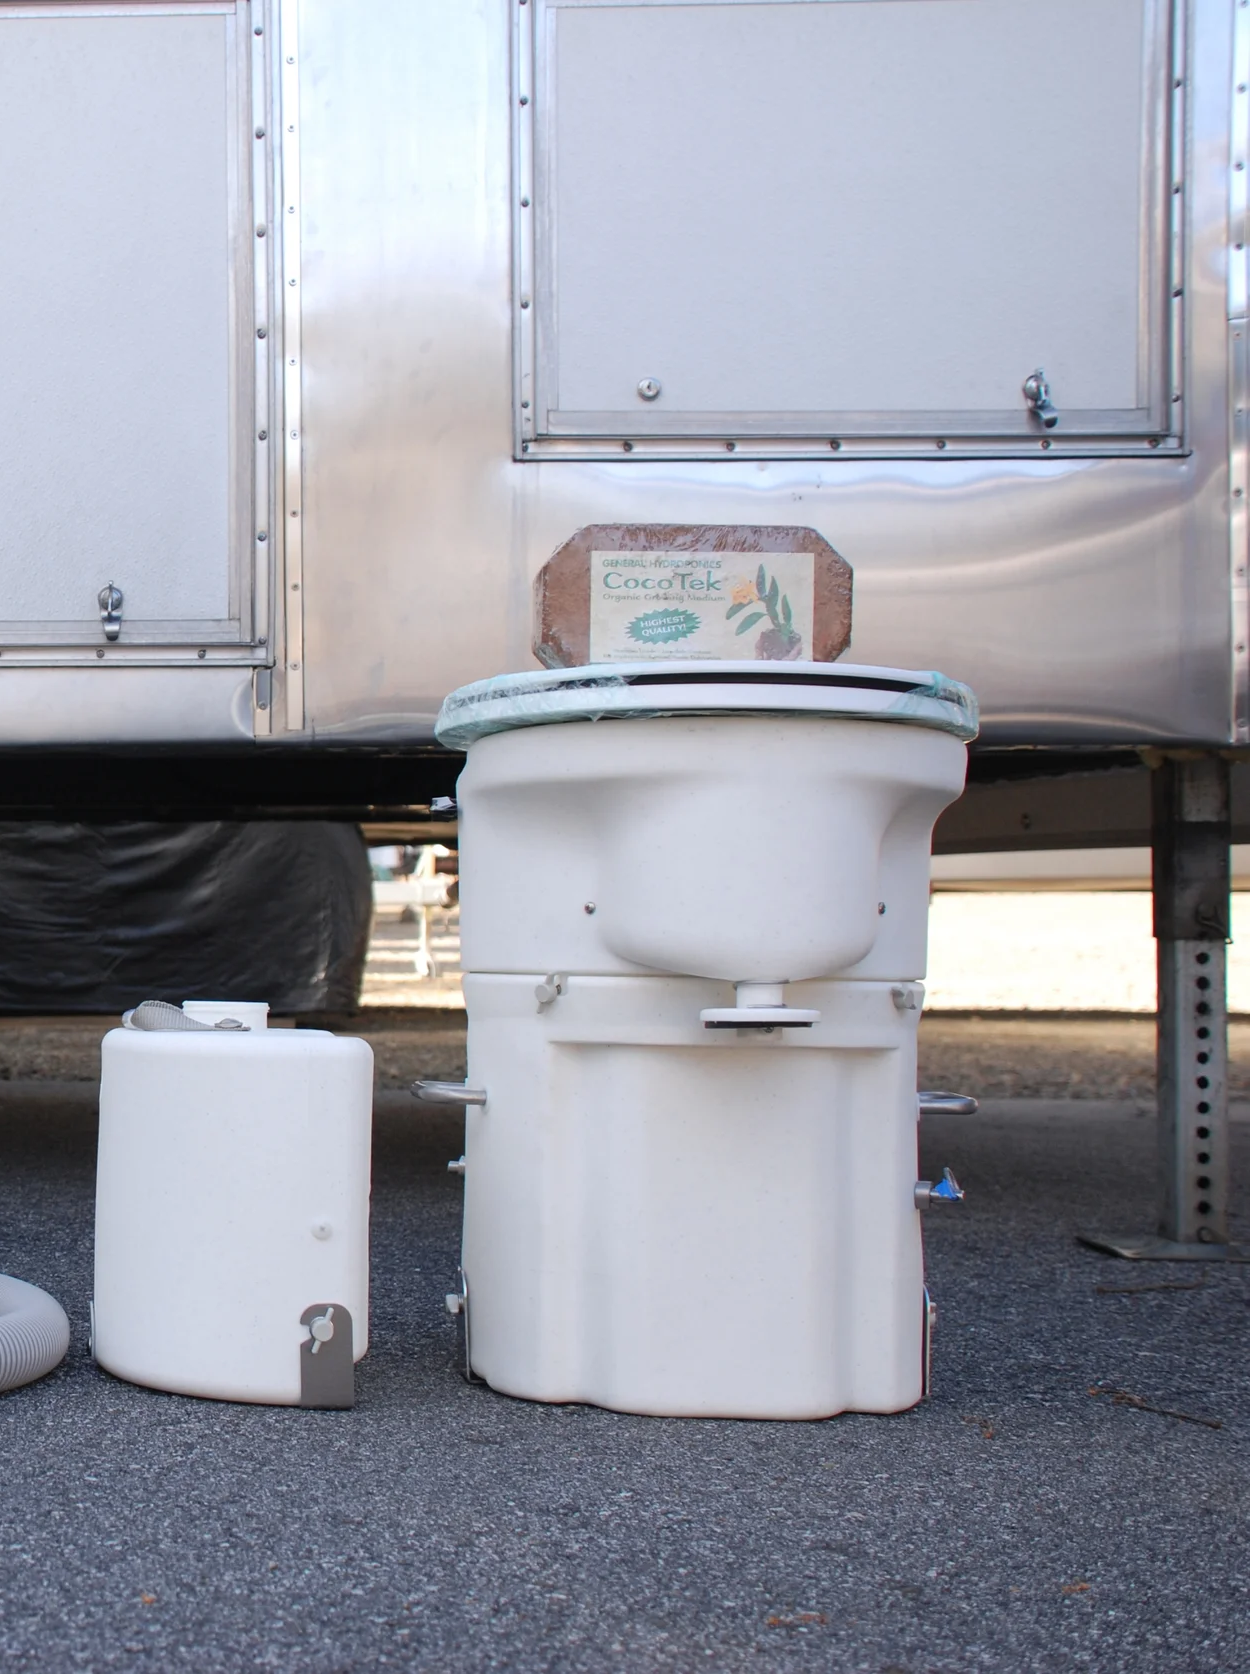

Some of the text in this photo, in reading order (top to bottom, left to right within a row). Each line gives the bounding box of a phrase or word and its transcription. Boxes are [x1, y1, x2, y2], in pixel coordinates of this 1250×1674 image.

[602, 559, 722, 569] GENERAL HYDROPONICS
[602, 593, 641, 603] Organic
[687, 593, 726, 602] Medium
[640, 615, 685, 628] HIGHEST
[641, 624, 687, 637] QUALITY!
